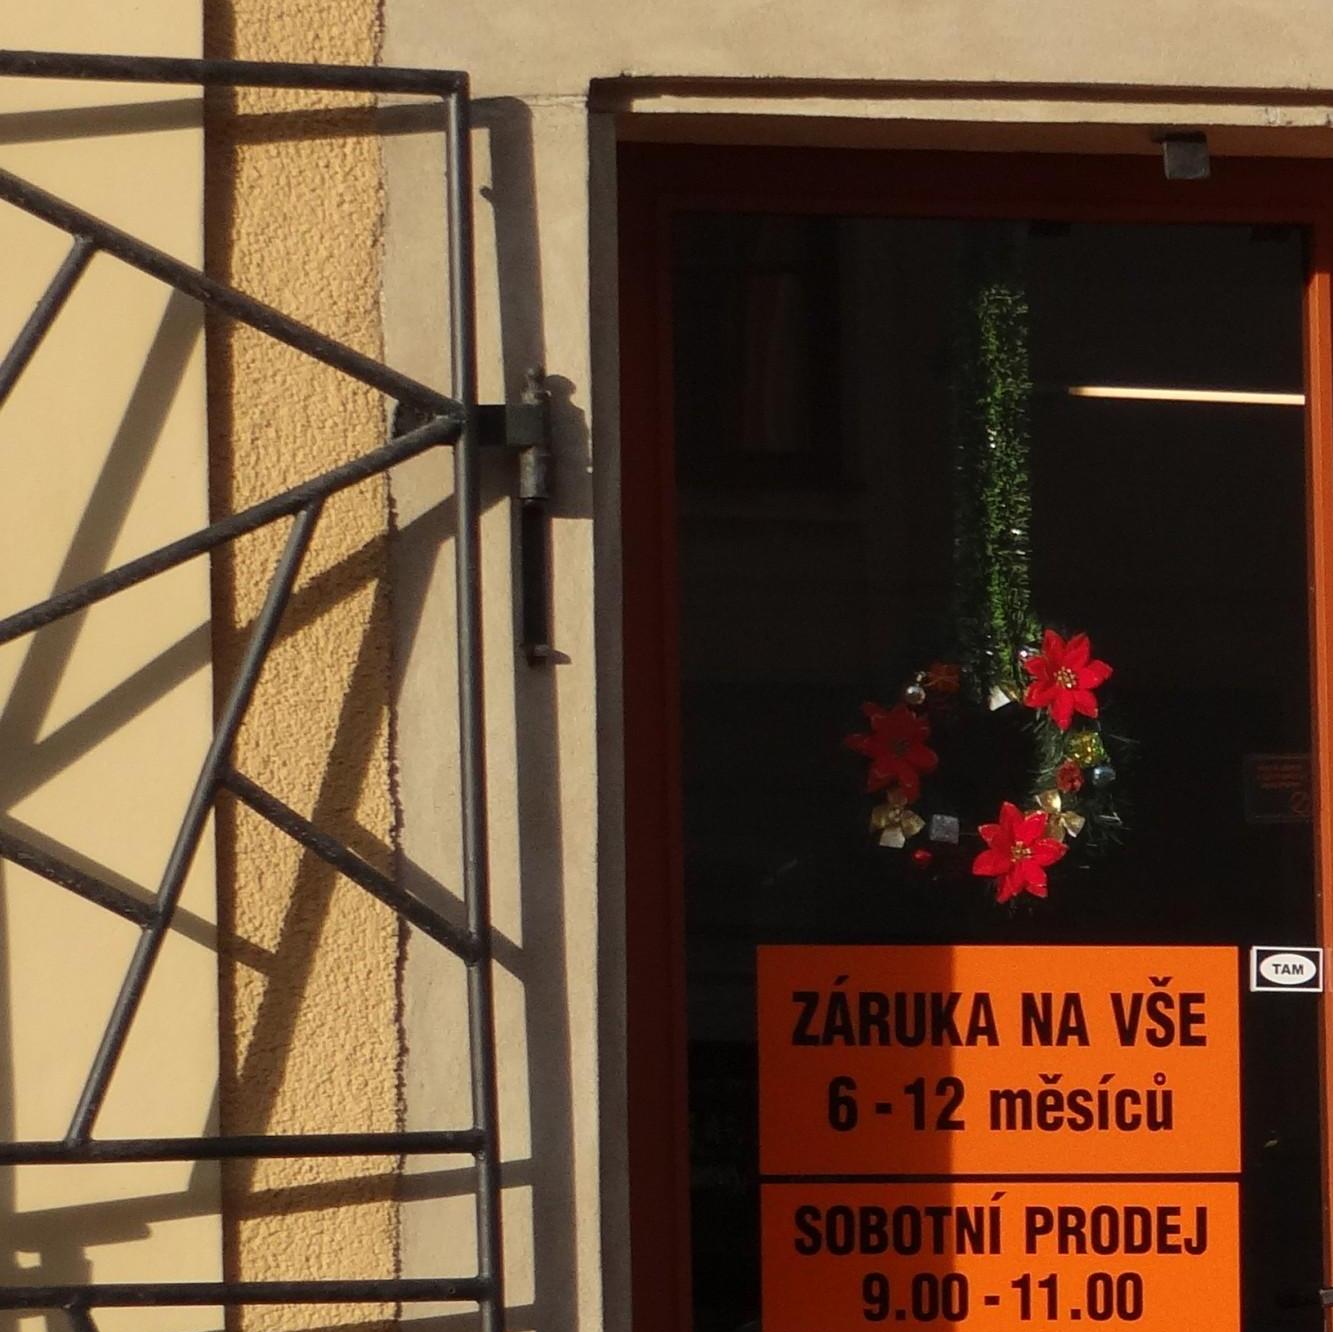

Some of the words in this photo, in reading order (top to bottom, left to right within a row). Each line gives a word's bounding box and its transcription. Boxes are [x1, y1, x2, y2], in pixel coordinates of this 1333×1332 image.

[1272, 963, 1304, 976] TAM
[792, 975, 999, 1047] ZÁRUKA
[1021, 992, 1089, 1047] NA
[1110, 976, 1208, 1047] VŠE
[990, 1073, 1173, 1132] měsíců
[794, 1192, 1006, 1255] SOBOTNÍ
[1026, 1206, 1208, 1255] PRODEJ
